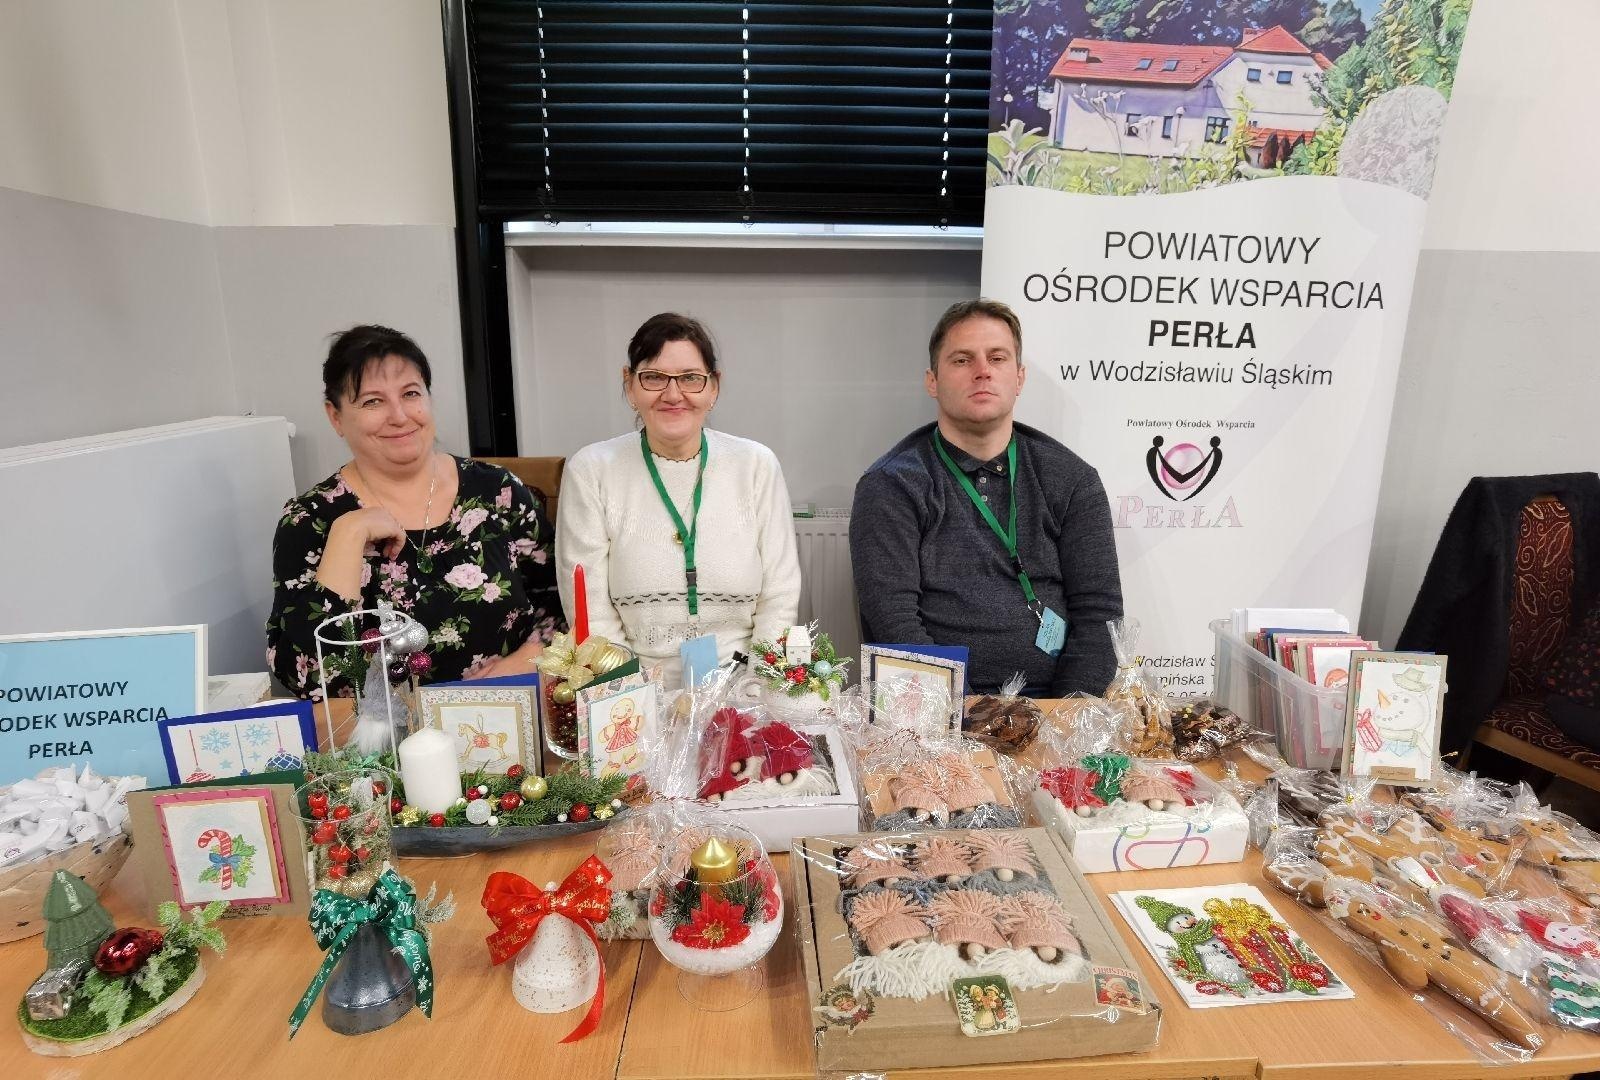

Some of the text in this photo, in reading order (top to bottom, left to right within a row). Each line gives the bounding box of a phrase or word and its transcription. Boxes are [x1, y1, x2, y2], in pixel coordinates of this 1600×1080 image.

[1104, 230, 1322, 265] POWIATOWY
[1023, 266, 1384, 310] OŚRODEK WSPARCIA
[1147, 319, 1257, 349] PERŁA
[1060, 357, 1333, 390] w Wodzisławiu Śląskim
[1126, 418, 1256, 431] Powiatowy Ośrodek Wsparcia
[0, 706, 169, 733] ODEK WSPARCIA
[28, 740, 94, 760] PERŁA
